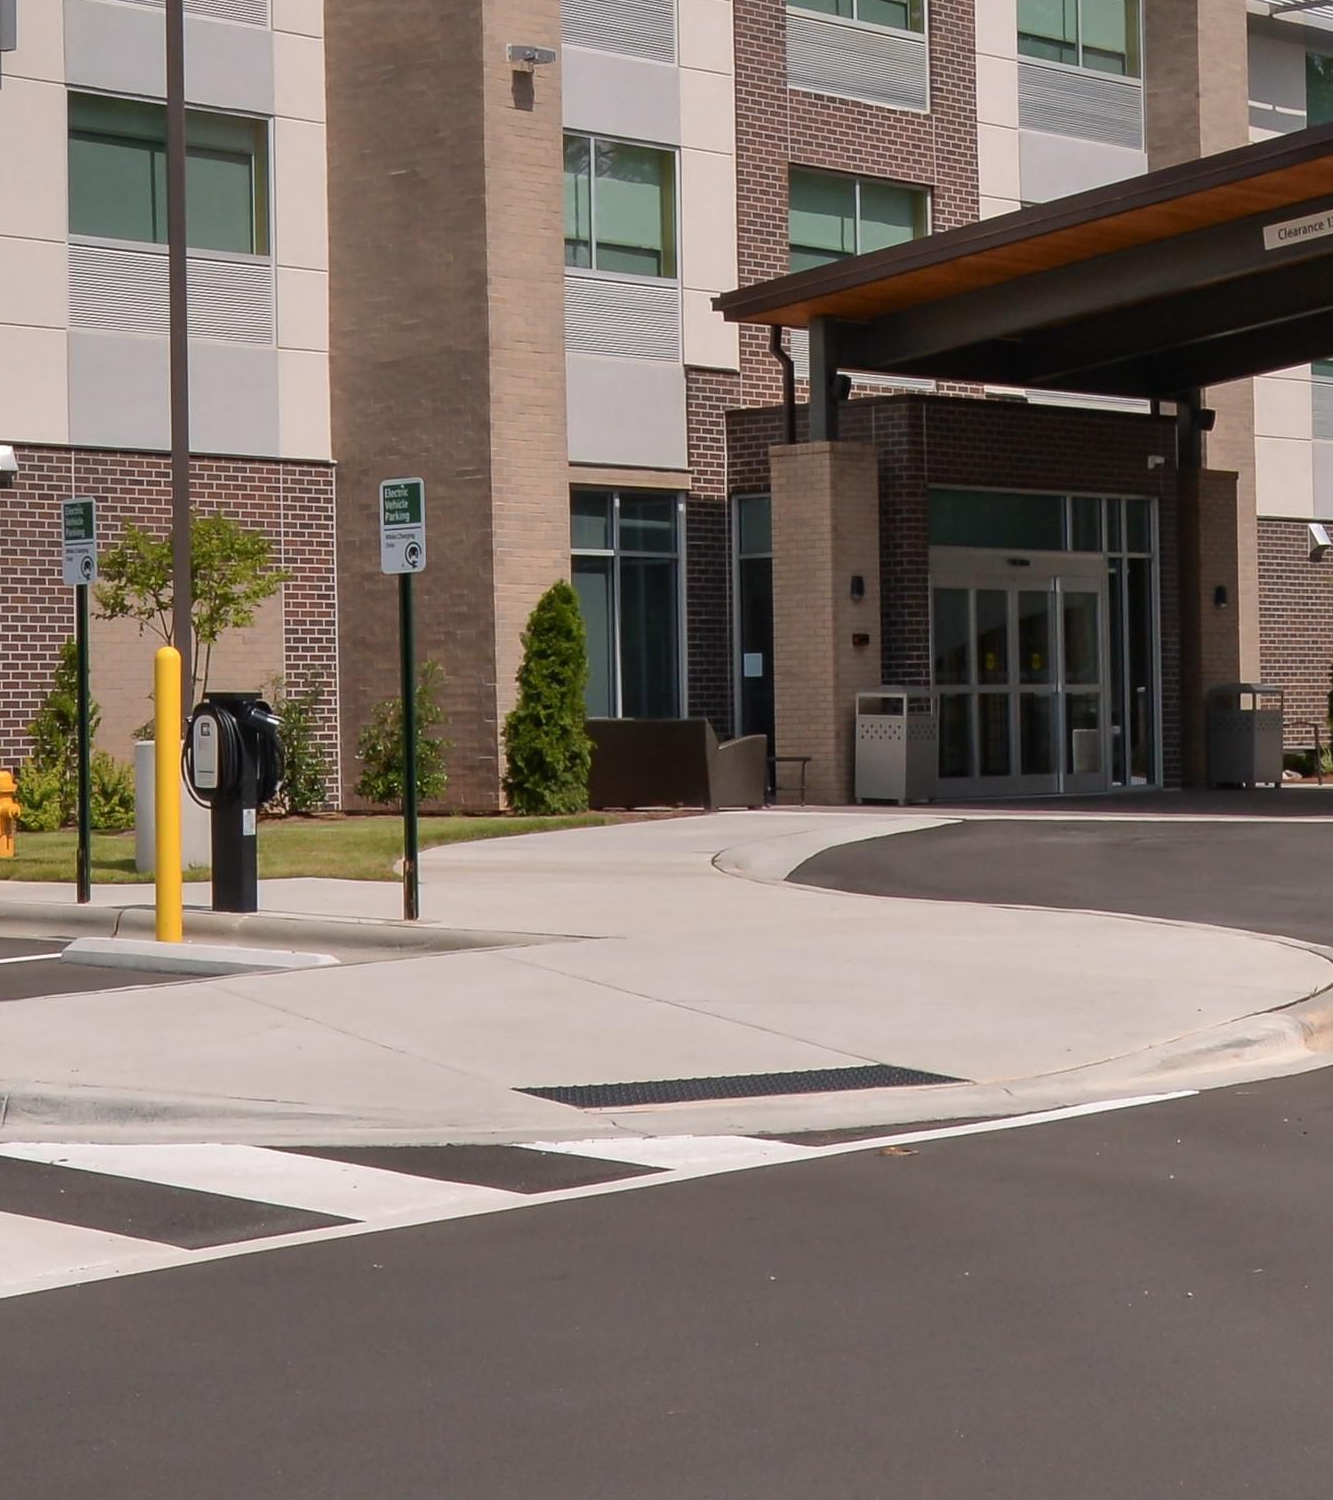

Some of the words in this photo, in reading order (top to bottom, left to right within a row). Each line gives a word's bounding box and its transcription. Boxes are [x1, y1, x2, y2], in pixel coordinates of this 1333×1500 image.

[1277, 220, 1324, 240] Clearance
[384, 486, 409, 499] Electric
[384, 499, 409, 511] Vehicle
[384, 510, 410, 523] Parking
